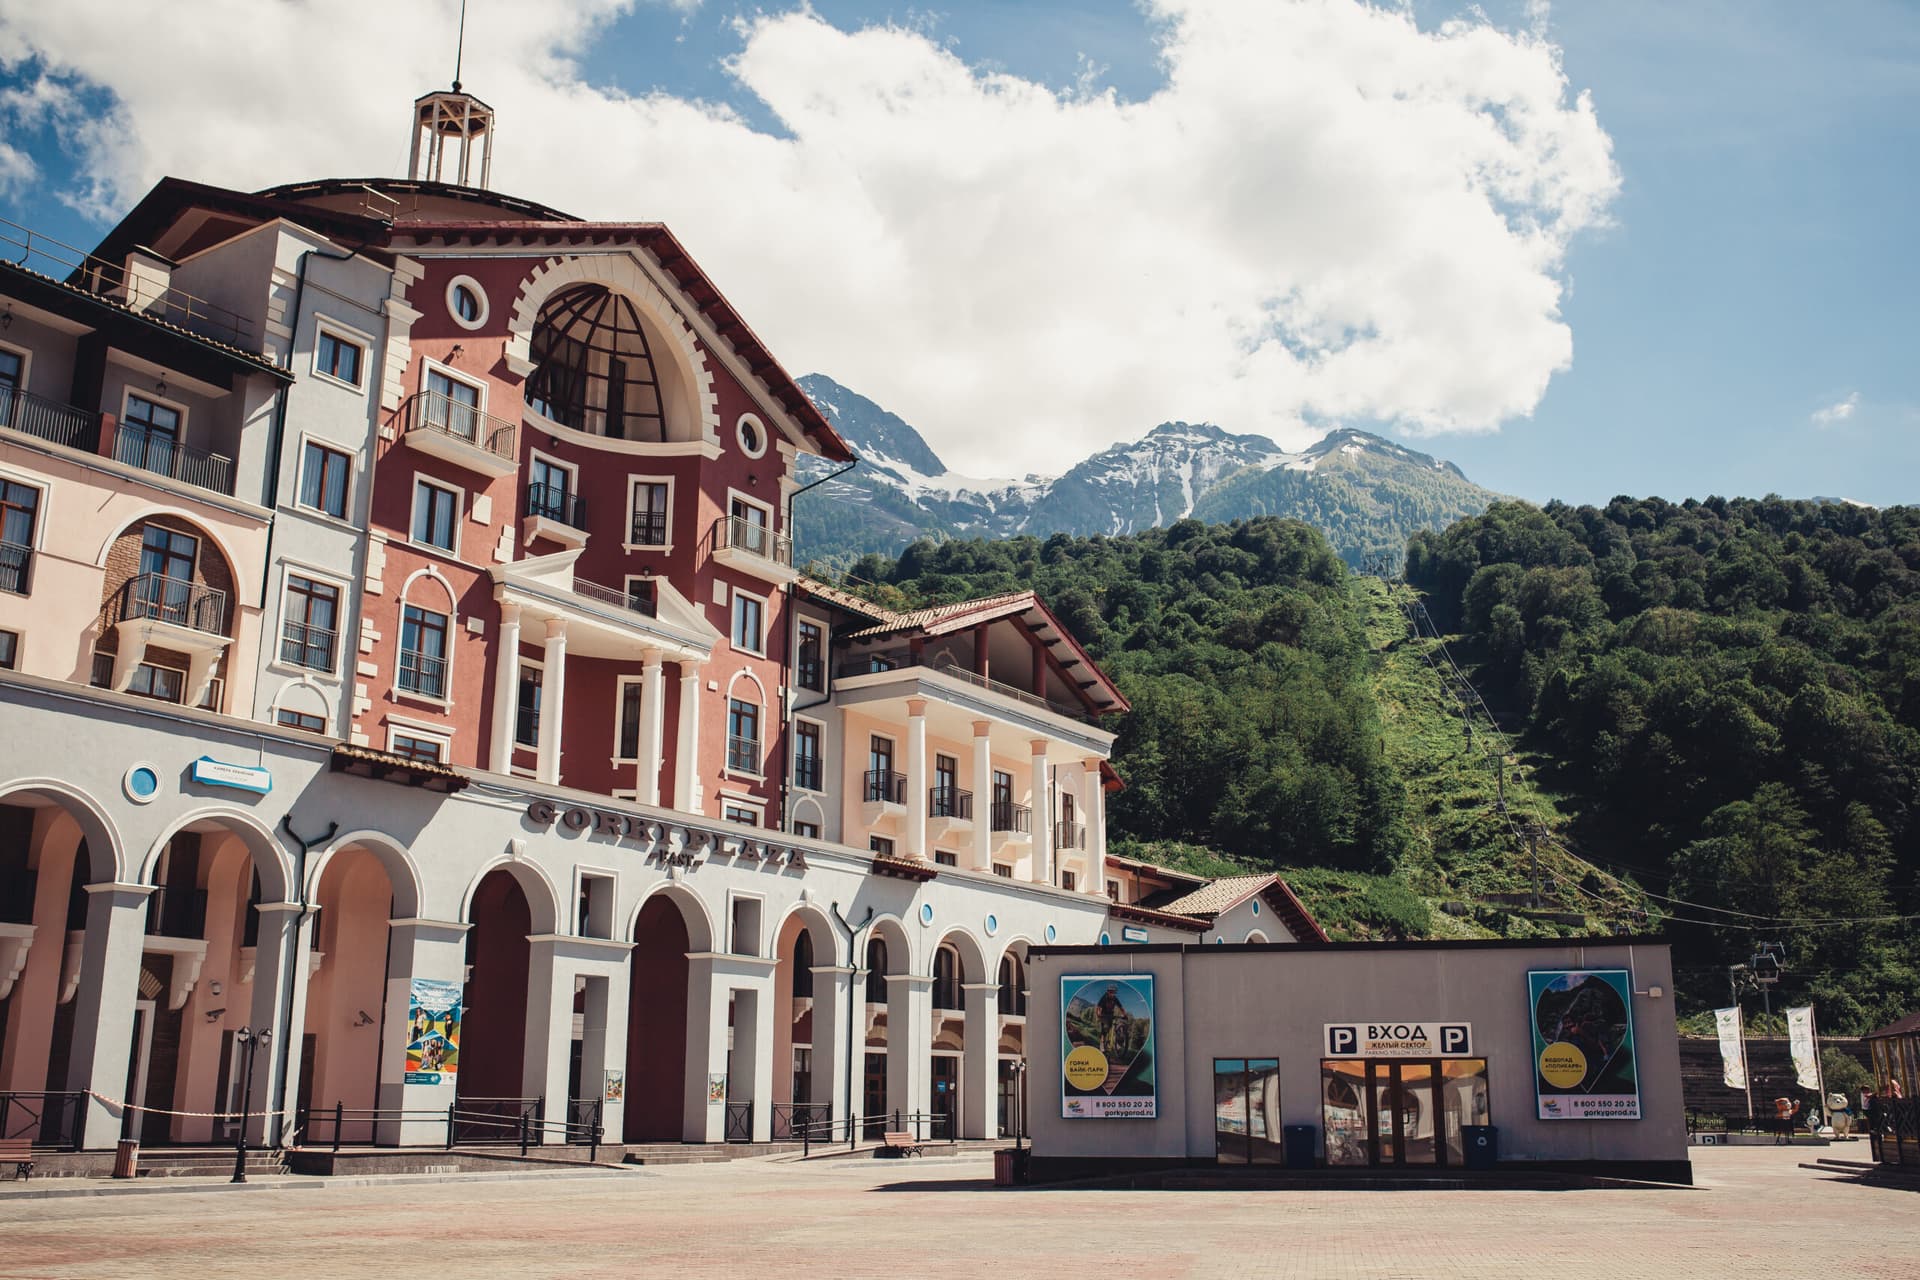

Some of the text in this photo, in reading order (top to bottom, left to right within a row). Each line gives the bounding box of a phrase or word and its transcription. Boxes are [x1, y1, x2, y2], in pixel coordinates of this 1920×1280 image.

[528, 801, 809, 871] GORKI PLAZA
[658, 851, 696, 868] EAST
[1334, 1028, 1353, 1053] P
[1368, 1025, 1427, 1041] ВХОД
[1445, 1028, 1464, 1052] P
[1371, 1041, 1426, 1049] ЖЕЛТЫЙ СЕКТОР
[1104, 1109, 1154, 1117] gorkygorod.ru
